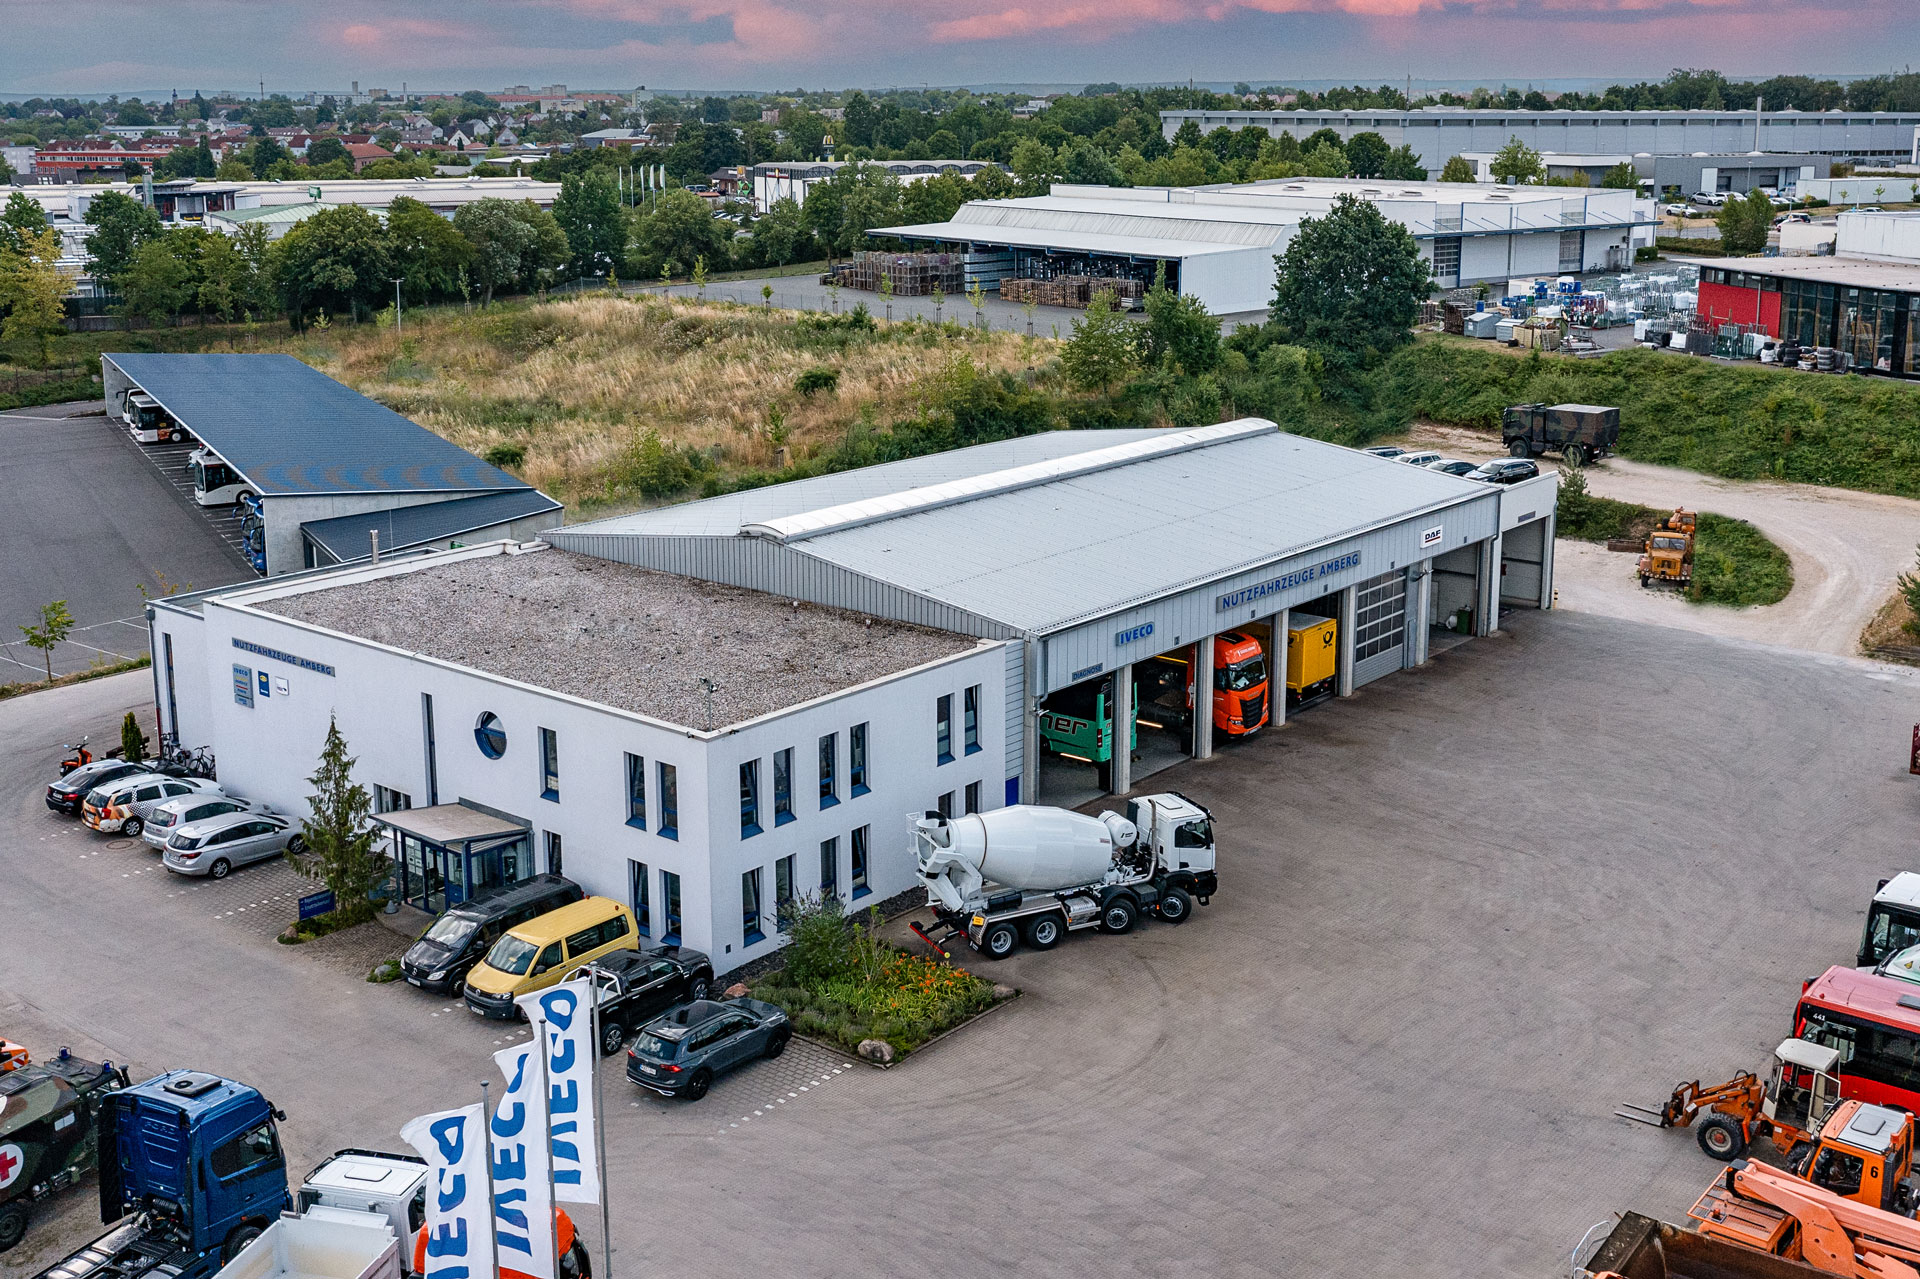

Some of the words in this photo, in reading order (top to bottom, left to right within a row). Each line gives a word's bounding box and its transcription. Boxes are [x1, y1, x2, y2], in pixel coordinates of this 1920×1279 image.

[1424, 529, 1441, 541] DAF
[1222, 568, 1315, 609] NUTZFAHRZEUGE
[1319, 553, 1359, 577] AMBERG
[1120, 623, 1153, 645] IVECO
[234, 639, 297, 665] NUTZFAHRZEUGE
[300, 658, 331, 675] AMBERG
[1072, 663, 1103, 680] DIAGNOSE
[1870, 1166, 1879, 1178] 6
